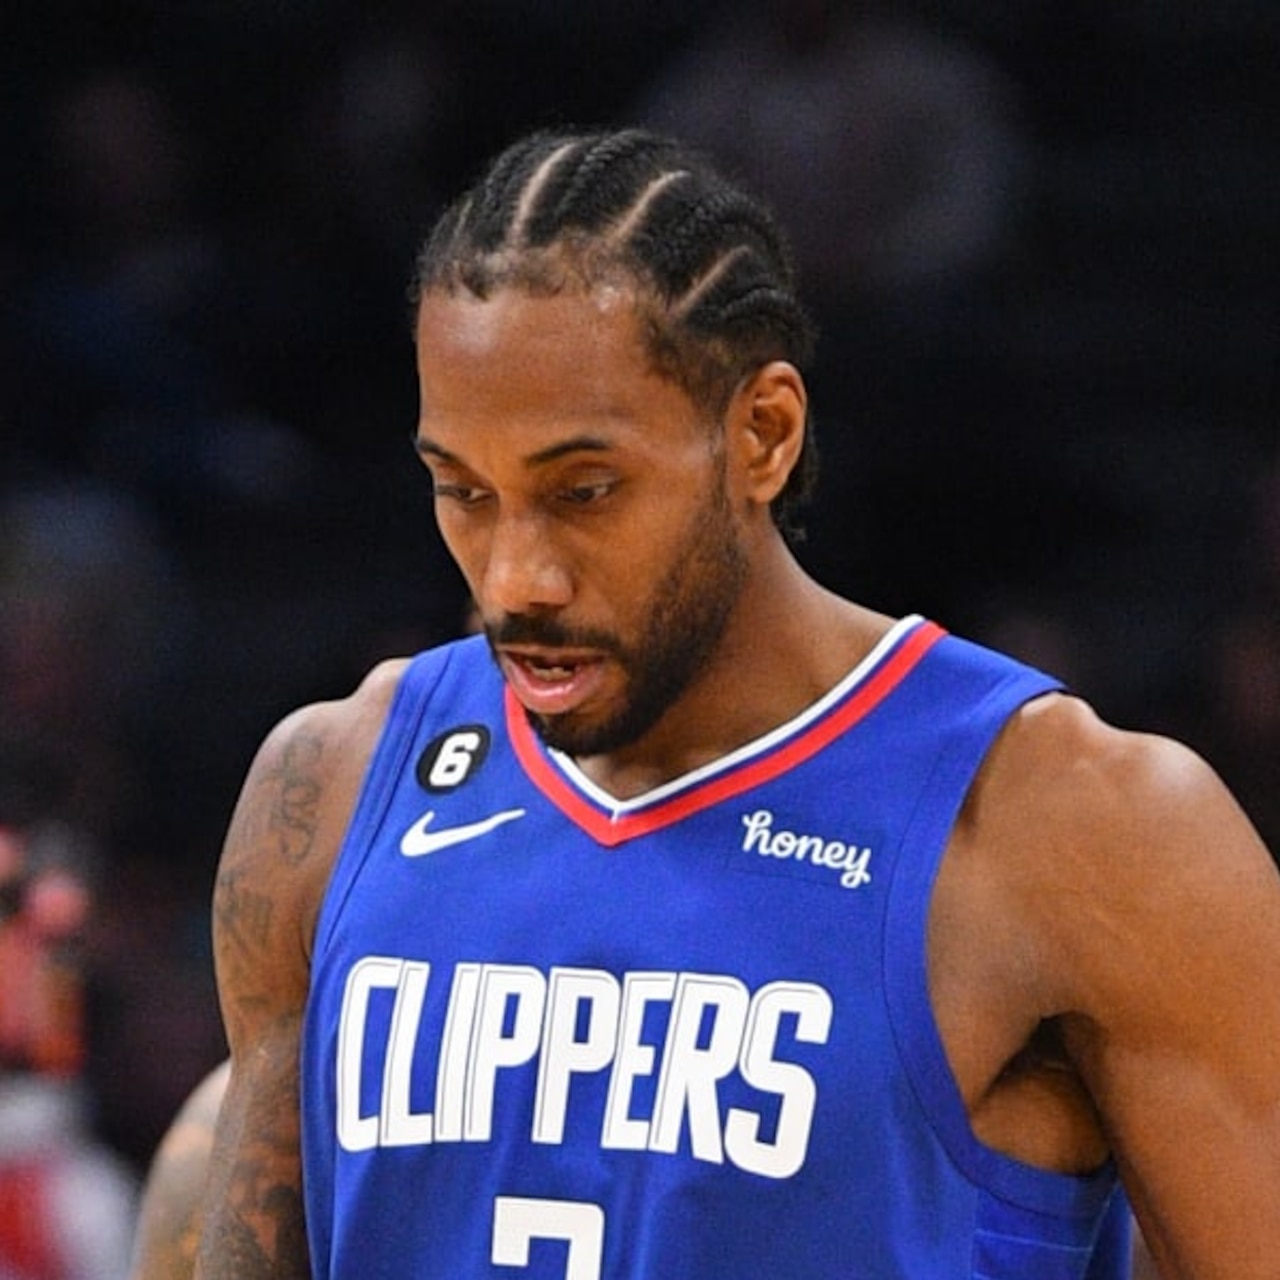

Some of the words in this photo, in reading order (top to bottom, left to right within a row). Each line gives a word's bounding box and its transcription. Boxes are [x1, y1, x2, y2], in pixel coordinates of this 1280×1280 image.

[429, 732, 481, 787] 6
[742, 810, 872, 889] honey
[335, 955, 834, 1180] CLIPPERS
